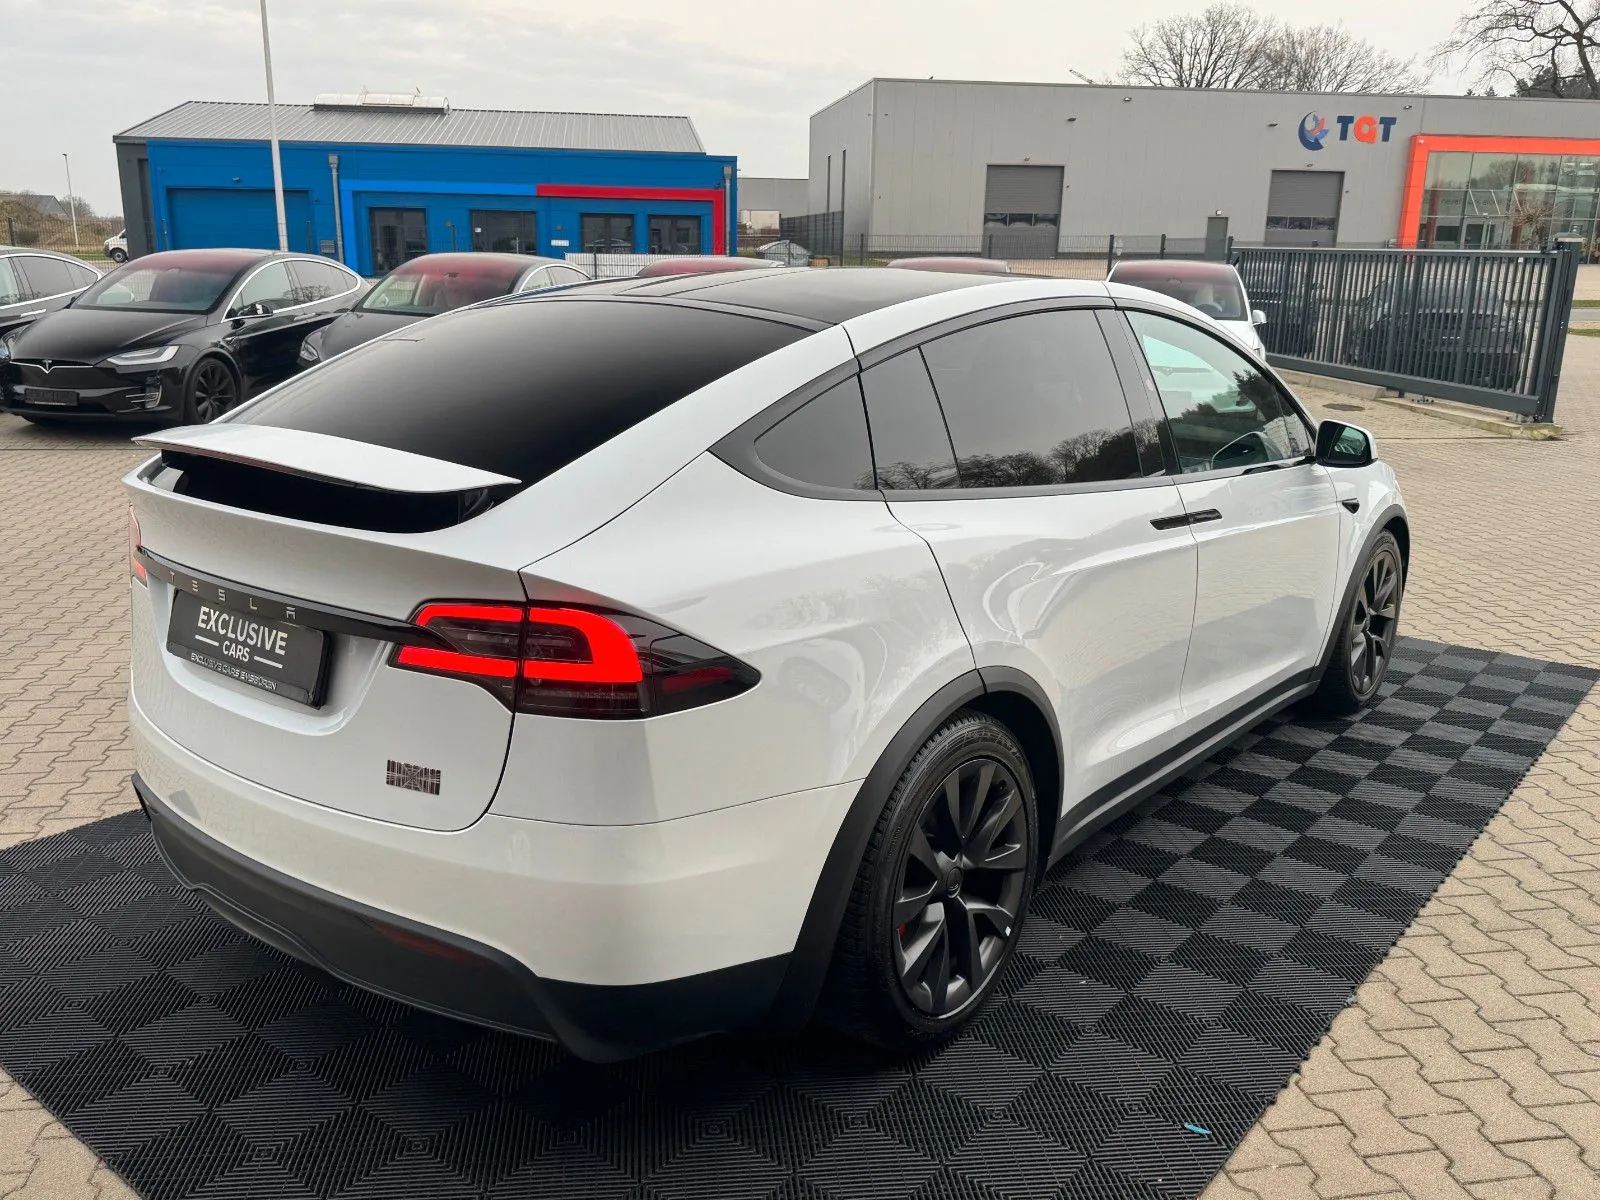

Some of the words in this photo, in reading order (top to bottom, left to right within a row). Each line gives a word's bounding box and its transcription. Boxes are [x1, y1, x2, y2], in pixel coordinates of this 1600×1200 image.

[1337, 115, 1397, 144] TGT
[169, 571, 296, 620] TESLA
[197, 606, 288, 656] EXCLUSIVE
[191, 652, 222, 671] EXCLUSIVE
[222, 664, 240, 677] CARS
[222, 641, 251, 662] CARS
